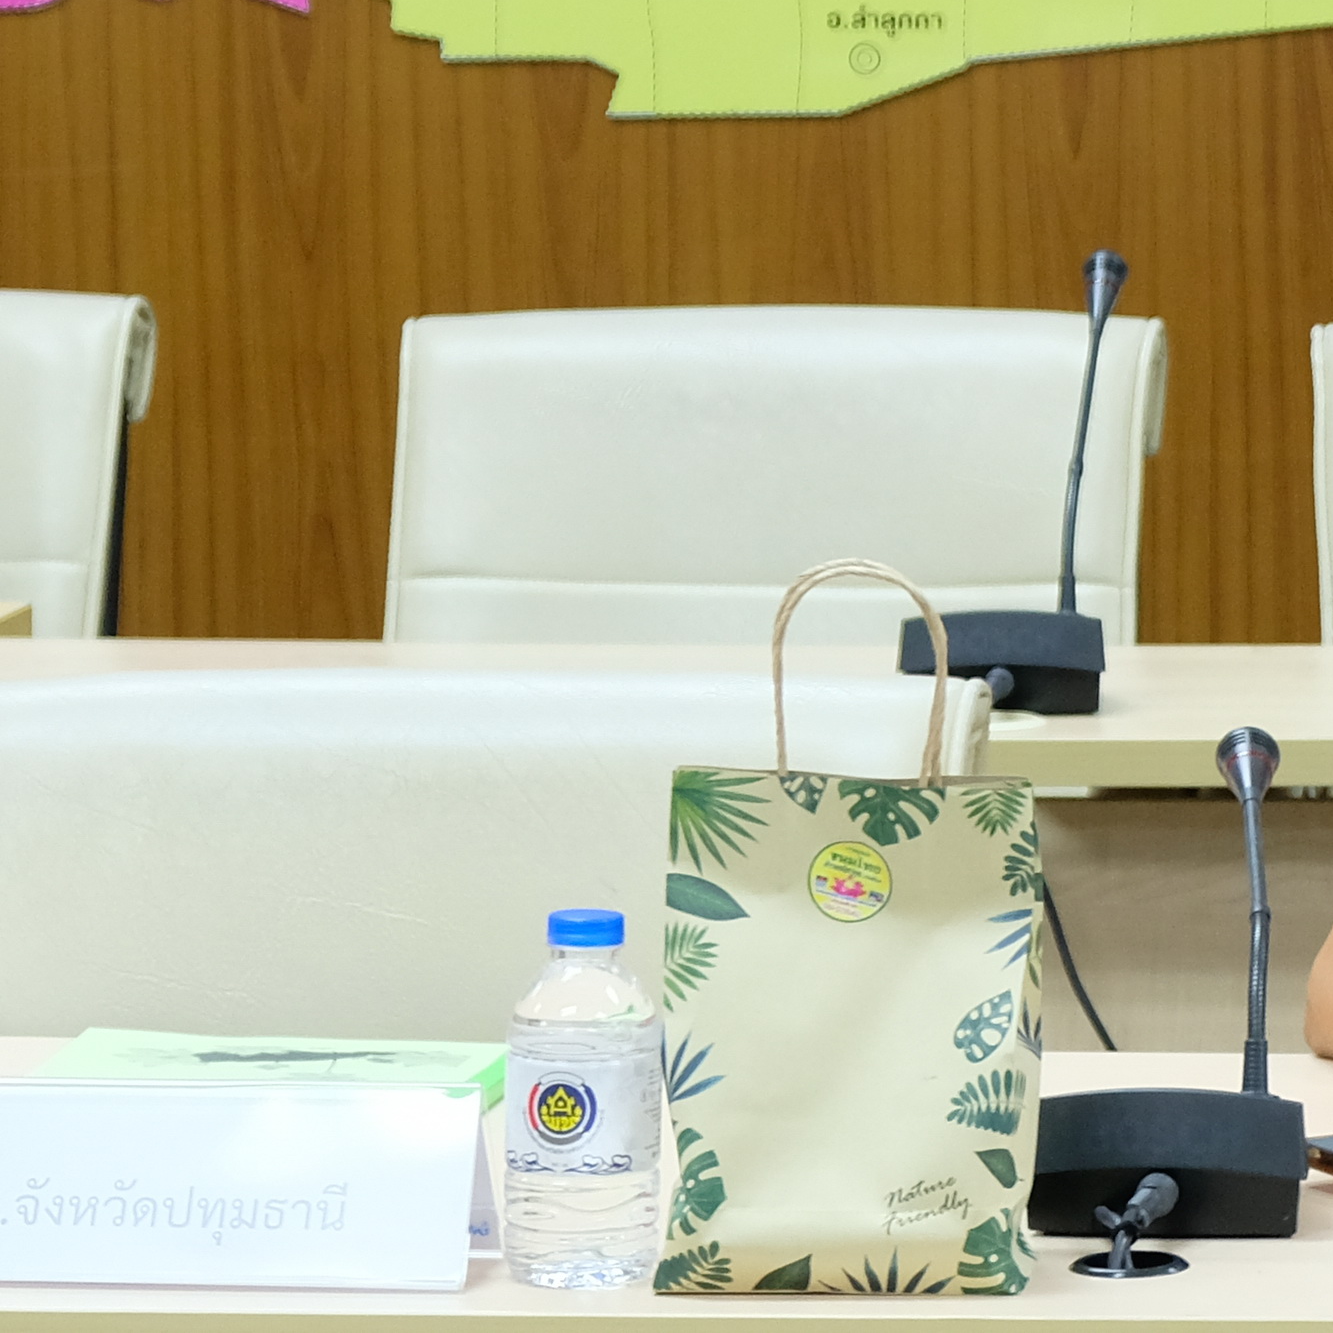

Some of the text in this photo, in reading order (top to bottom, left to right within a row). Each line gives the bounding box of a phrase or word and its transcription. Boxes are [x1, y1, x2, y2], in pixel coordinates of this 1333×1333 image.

[827, 5, 942, 38] อ.ลำลูกกา
[885, 1177, 957, 1208] Nature
